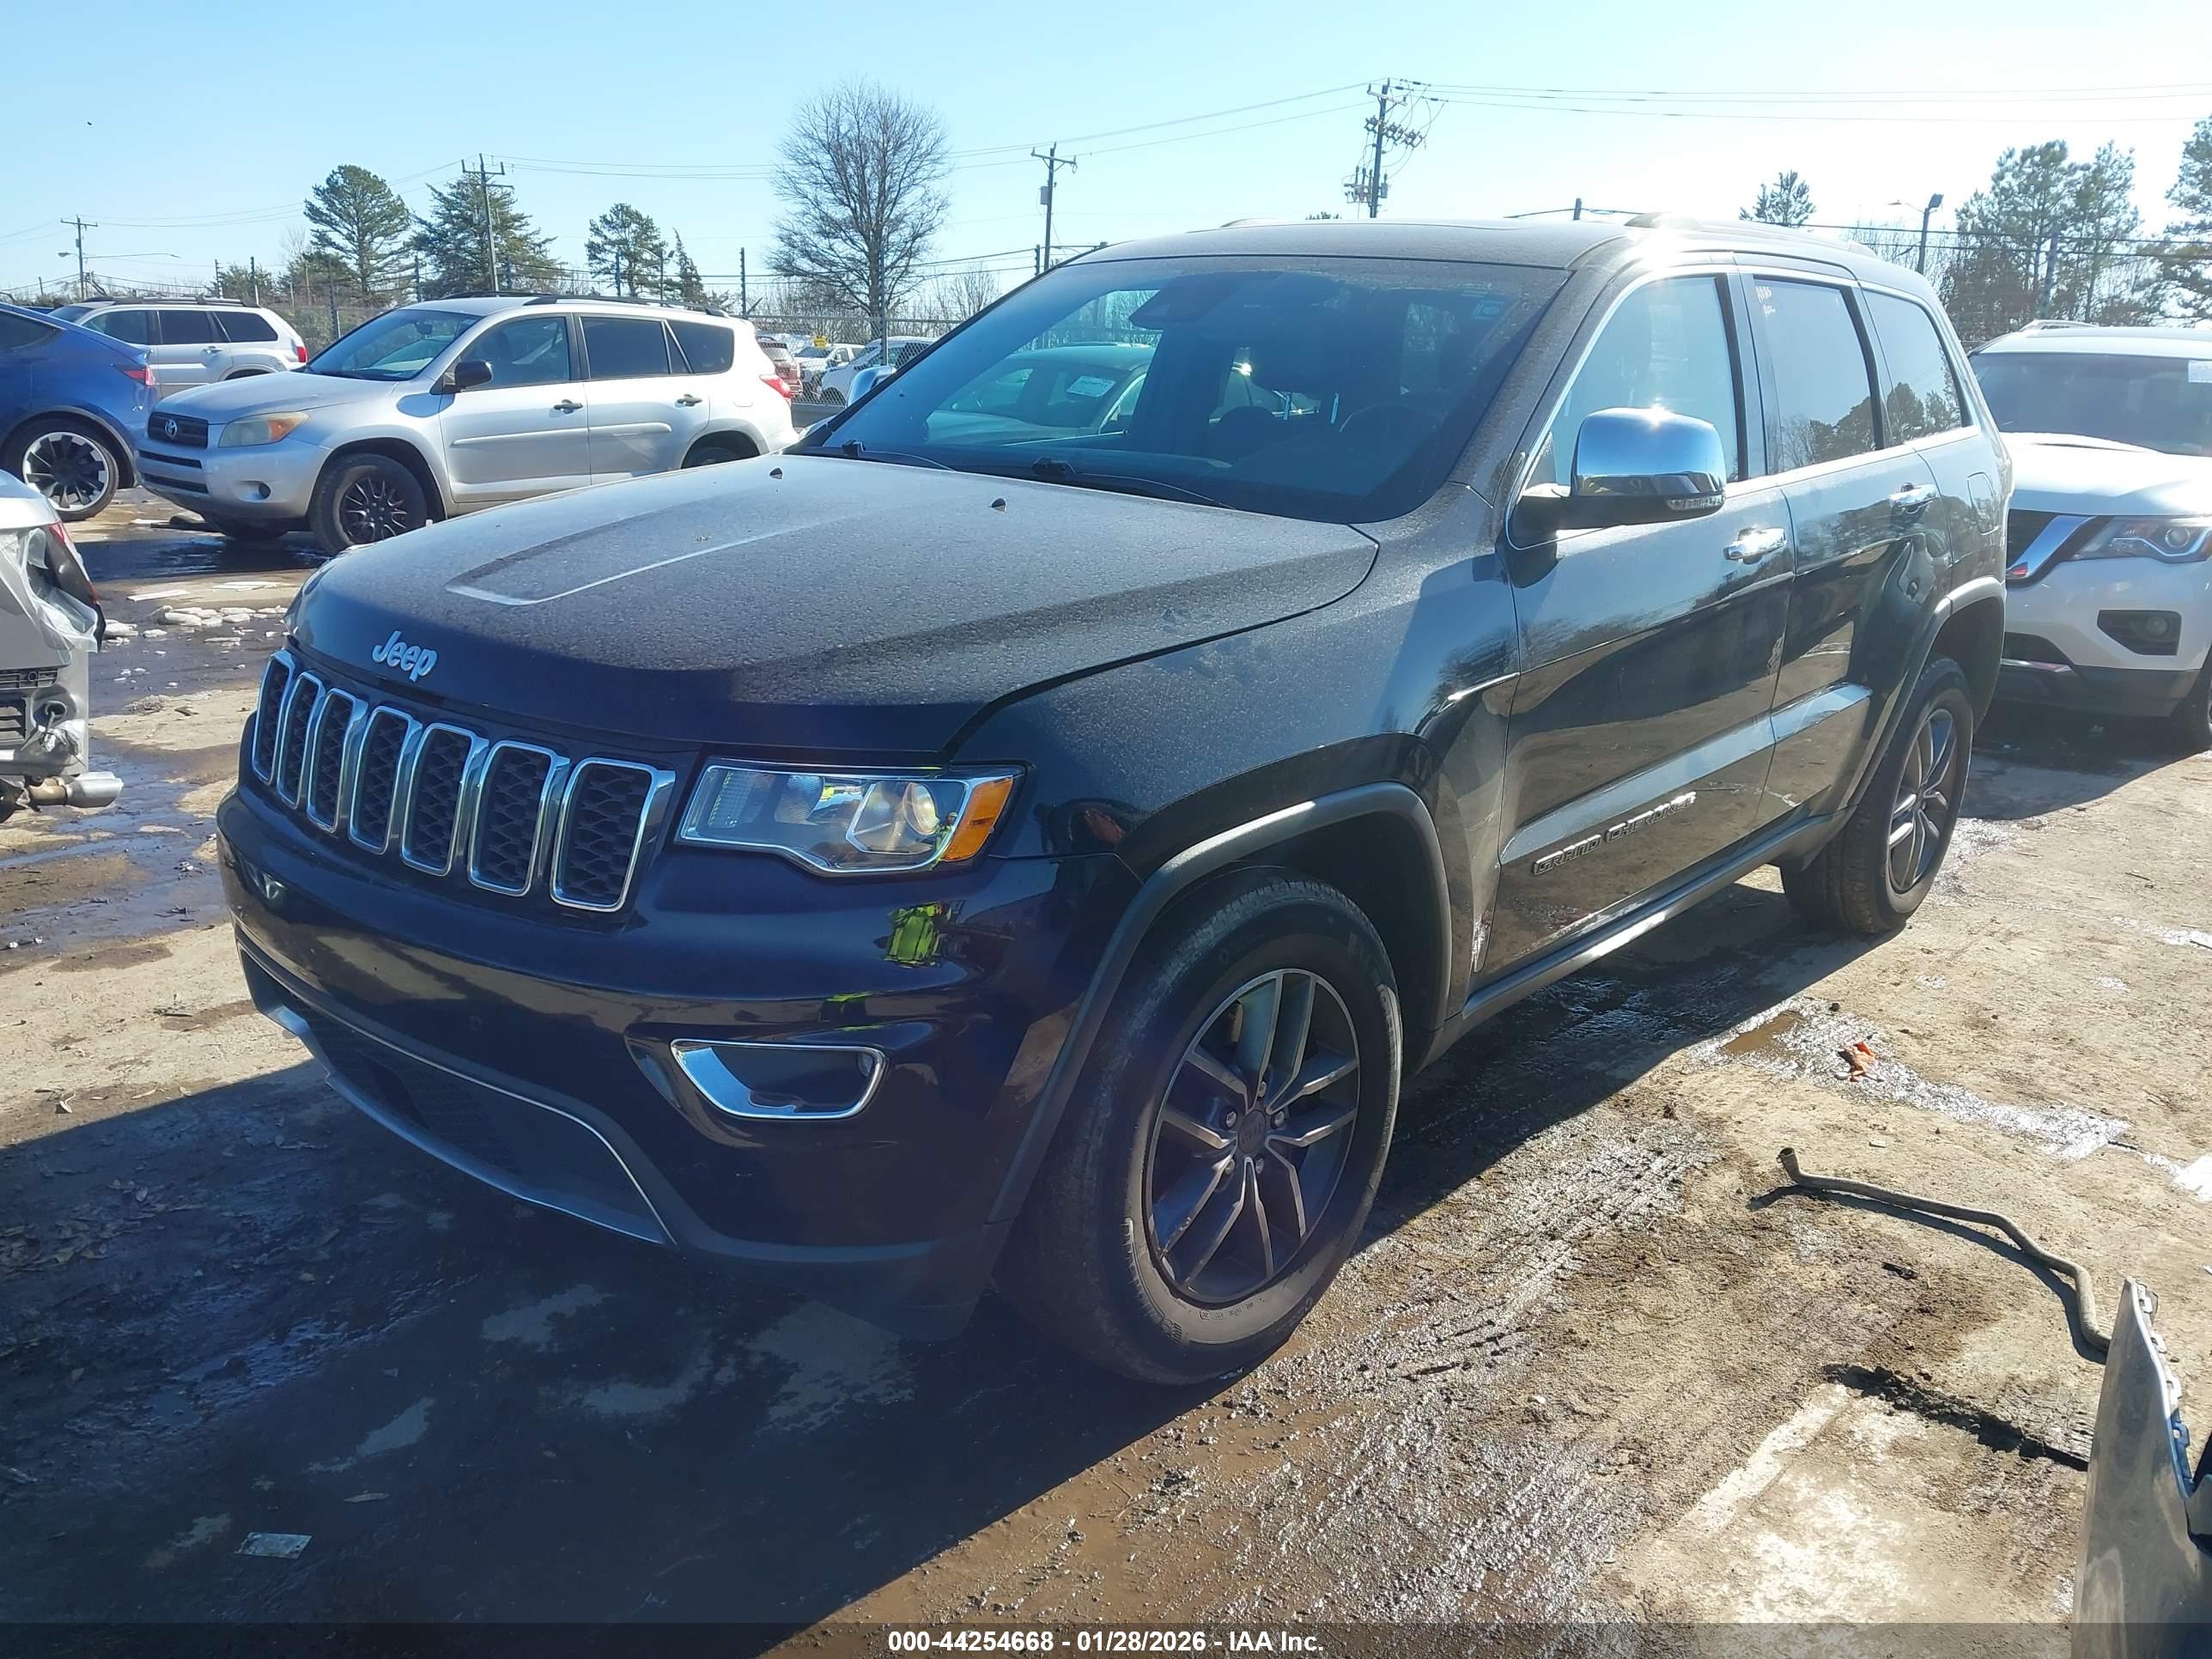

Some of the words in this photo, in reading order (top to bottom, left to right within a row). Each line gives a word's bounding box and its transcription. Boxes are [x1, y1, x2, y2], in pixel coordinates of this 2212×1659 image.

[372, 630, 438, 682] Jeep
[1534, 834, 1601, 875] GRAND
[1605, 791, 1697, 842] CHEROKEE
